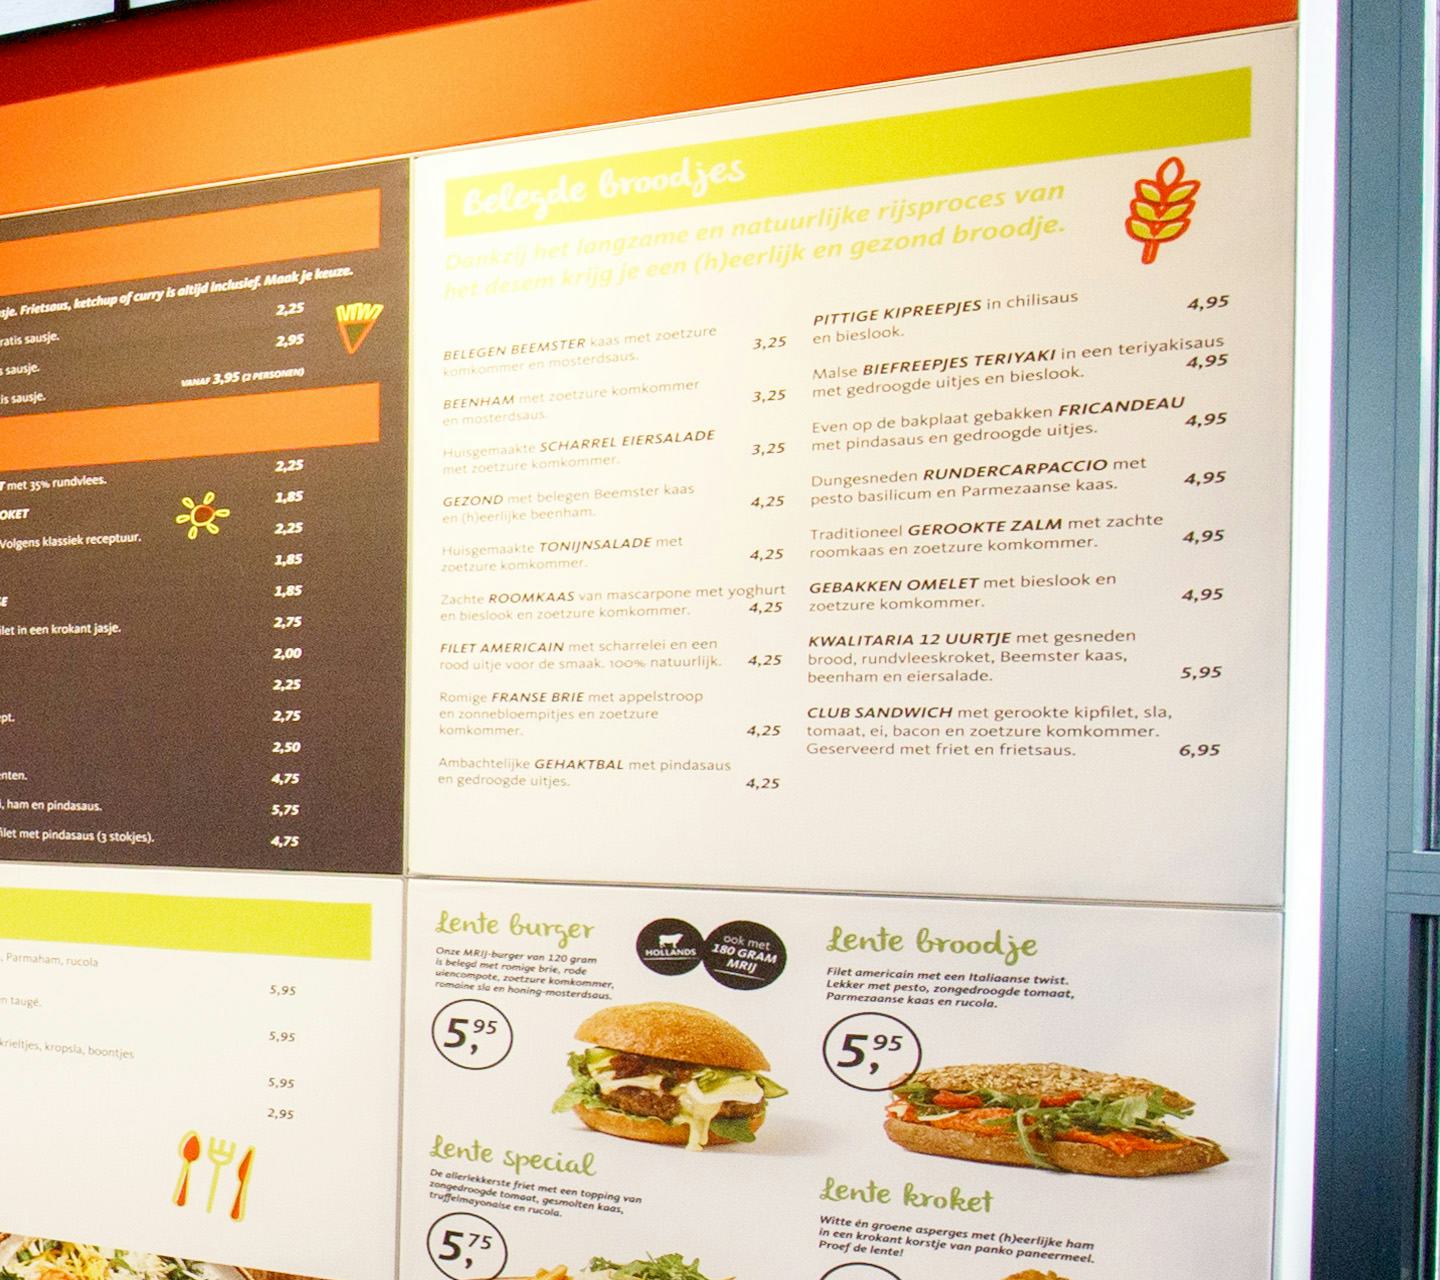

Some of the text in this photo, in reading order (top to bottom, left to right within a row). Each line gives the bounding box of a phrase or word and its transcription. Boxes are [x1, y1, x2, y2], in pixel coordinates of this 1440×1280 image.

[463, 157, 747, 221] Belegde broodjes
[275, 302, 305, 316] 2,25
[1187, 294, 1230, 313] 4,95
[813, 299, 982, 328] PITTIGE KIPREEPJES
[275, 334, 305, 348] 2,95
[753, 336, 787, 350] 3,25
[923, 460, 1108, 481] RUNDERCARPACCIO
[808, 631, 1012, 648] KWALITARIA 12 UURTJE
[807, 705, 953, 720] CLUB SANDWICH
[272, 741, 301, 754] 2,50
[1180, 743, 1221, 758] 6,95
[435, 910, 596, 949] Lente burger
[724, 933, 771, 950] ook met
[826, 925, 1039, 966] Lente broodje
[645, 946, 697, 957] HOLLANDS
[711, 943, 778, 964] 180 GRAM
[726, 958, 757, 973] MRIJ
[269, 984, 297, 996] 5,95
[443, 1017, 498, 1056] 5,95
[837, 1033, 903, 1075] 5,95
[429, 1134, 597, 1178] Lente special
[819, 1176, 994, 1214] Lente kroket
[438, 1229, 493, 1270] 5,75
